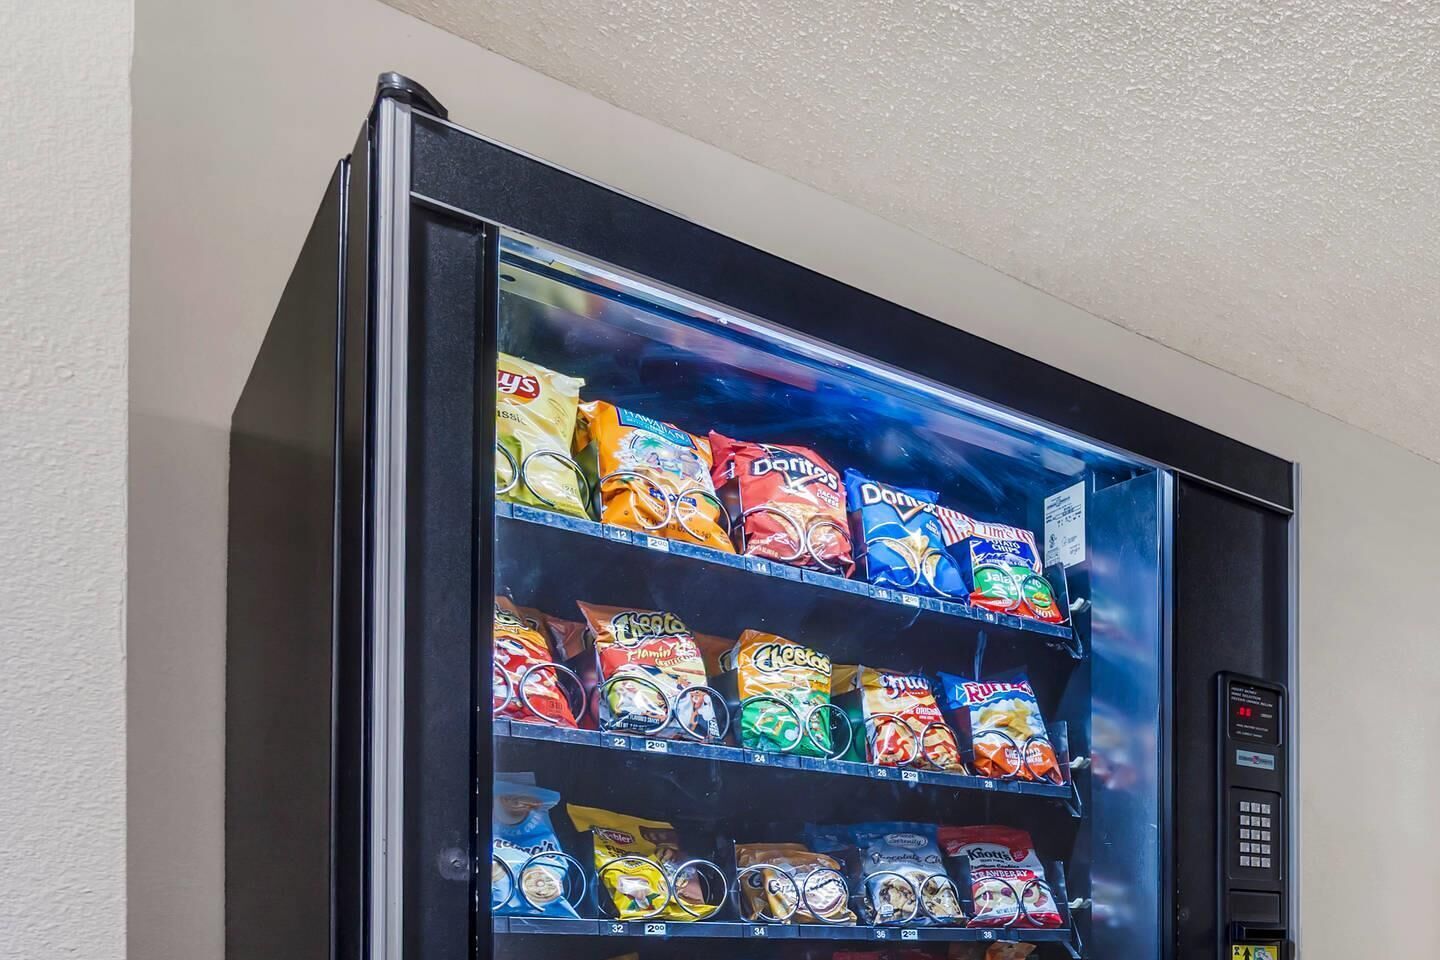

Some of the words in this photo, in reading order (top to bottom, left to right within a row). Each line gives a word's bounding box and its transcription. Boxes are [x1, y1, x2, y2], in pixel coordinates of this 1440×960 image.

[753, 456, 839, 491] Doritos
[615, 530, 627, 539] 12
[756, 563, 767, 572] 14
[985, 612, 994, 621] 18
[626, 645, 673, 662] Flamin'
[753, 644, 831, 676] Cheetos
[614, 738, 626, 747] 22
[754, 754, 766, 763] 24
[877, 768, 887, 777] 26
[984, 780, 993, 788] 28
[967, 847, 1012, 862] Knott's
[612, 924, 624, 933] 32
[754, 927, 765, 936] 34
[876, 930, 886, 938] 36
[983, 931, 993, 939] 38
